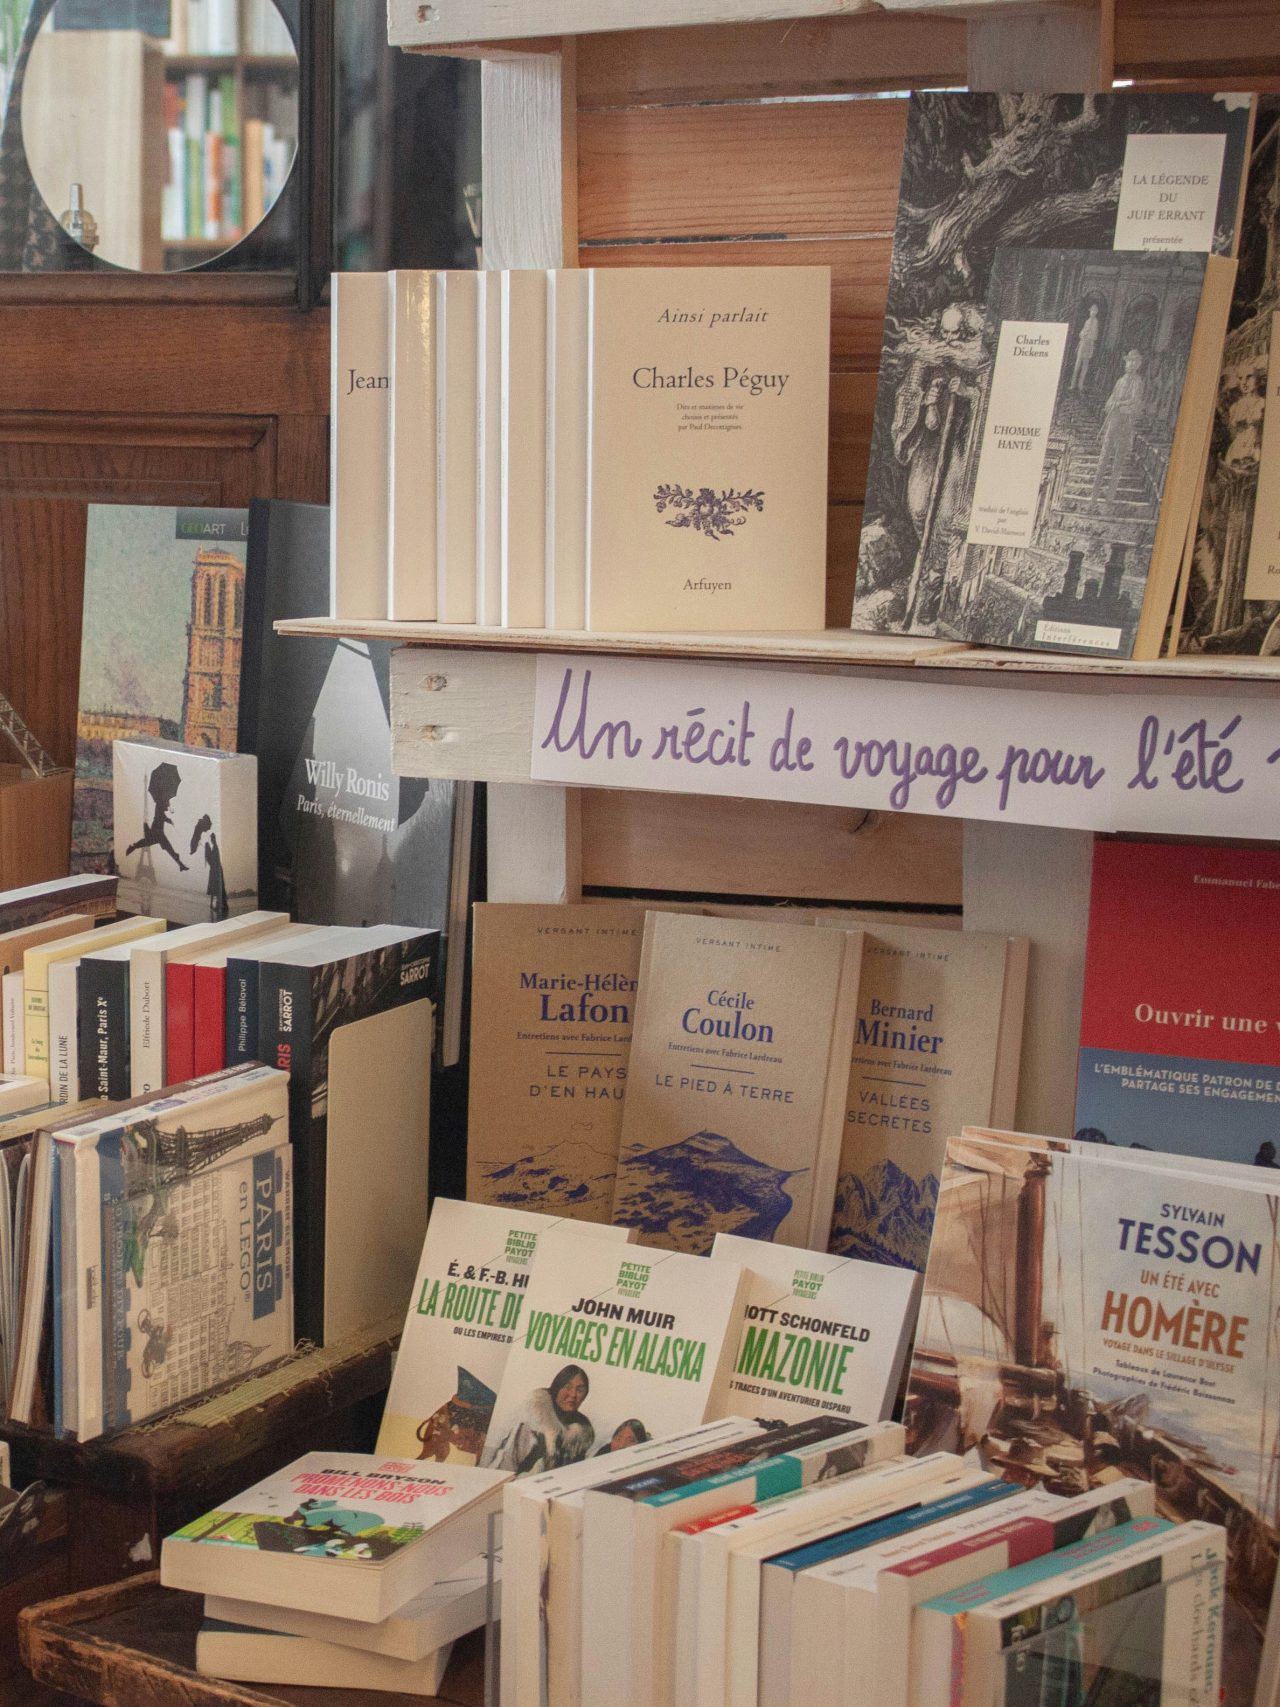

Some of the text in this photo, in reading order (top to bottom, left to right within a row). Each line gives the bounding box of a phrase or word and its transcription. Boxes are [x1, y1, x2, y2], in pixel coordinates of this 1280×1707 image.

[1133, 173, 1209, 186] LA LÉGENDE
[1160, 193, 1178, 203] DU
[1127, 210, 1205, 220] JUIF ERRANT
[657, 307, 769, 328] Ainsi parlait
[1012, 346, 1049, 358] Dickens
[1015, 335, 1050, 347] Charles
[632, 366, 789, 396] Charles Péguy
[997, 439, 1033, 451] HANTÉ
[682, 578, 732, 594] Arfuyen
[540, 667, 1243, 812] Un récit de voyage pour l'été
[304, 758, 389, 802] Willy Ronis
[296, 794, 396, 833] Paris, éternellement
[1193, 874, 1253, 888] Emmanuel
[695, 936, 781, 953] VERSANT INTIME
[400, 963, 431, 986] SARROT
[283, 989, 292, 1032] SARROT
[539, 993, 630, 1024] Lafon
[706, 989, 755, 1011] Cécile
[869, 1000, 933, 1024] Bernard
[1135, 1003, 1267, 1034] Ouvrir une
[238, 1015, 249, 1052] Philippe
[681, 1006, 775, 1044] Coulon
[854, 1018, 944, 1056] Minier
[58, 1035, 68, 1081] DE LA LUNE
[97, 1009, 109, 1092] Saint-Maur, Paris
[667, 1041, 750, 1061] Entretiens Fabrice
[546, 1065, 627, 1080] LE PAYS
[1094, 1063, 1273, 1090] L'EMBLÉMATIQUE PATRON DE
[528, 1085, 577, 1099] D'EN
[655, 1074, 795, 1104] LE PIED TERRE
[1121, 1078, 1200, 1095] PARTAGE SES
[859, 1090, 931, 1112] VALLÉES
[239, 1181, 249, 1210] en
[1160, 1203, 1225, 1228] SYLVAIN
[256, 1175, 273, 1293] PARIS
[506, 1238, 536, 1250] BIBLIO
[508, 1229, 538, 1241] PETITE
[504, 1246, 534, 1258] PAYOT
[1118, 1218, 1262, 1276] TESSON
[463, 1265, 476, 1280] &
[618, 1270, 649, 1283] BIBLIO
[620, 1261, 651, 1274] PETITE
[616, 1279, 647, 1292] PAYOT
[791, 1279, 823, 1293] PAYOT
[1140, 1269, 1220, 1298] UN ÉTÉ AVEC
[417, 1278, 487, 1325] LA ROUTE
[571, 1297, 676, 1331] JOHN MUIR
[1101, 1289, 1249, 1358] HOMÈRE
[475, 1329, 505, 1342] EMPIRES
[779, 1309, 871, 1343] SCHONFELD
[524, 1309, 708, 1383] VOYAGES EN ALASKA
[1103, 1338, 1197, 1366] VOYAGE DANS LE SILLAGE
[1092, 1366, 1146, 1386] Photographies
[734, 1382, 851, 1414] TRACES AVENTURIER DISPARU
[368, 1472, 447, 1485] BRYSON
[293, 1484, 421, 1505] DANS BOIS
[1204, 1604, 1221, 1695] Kerouac
